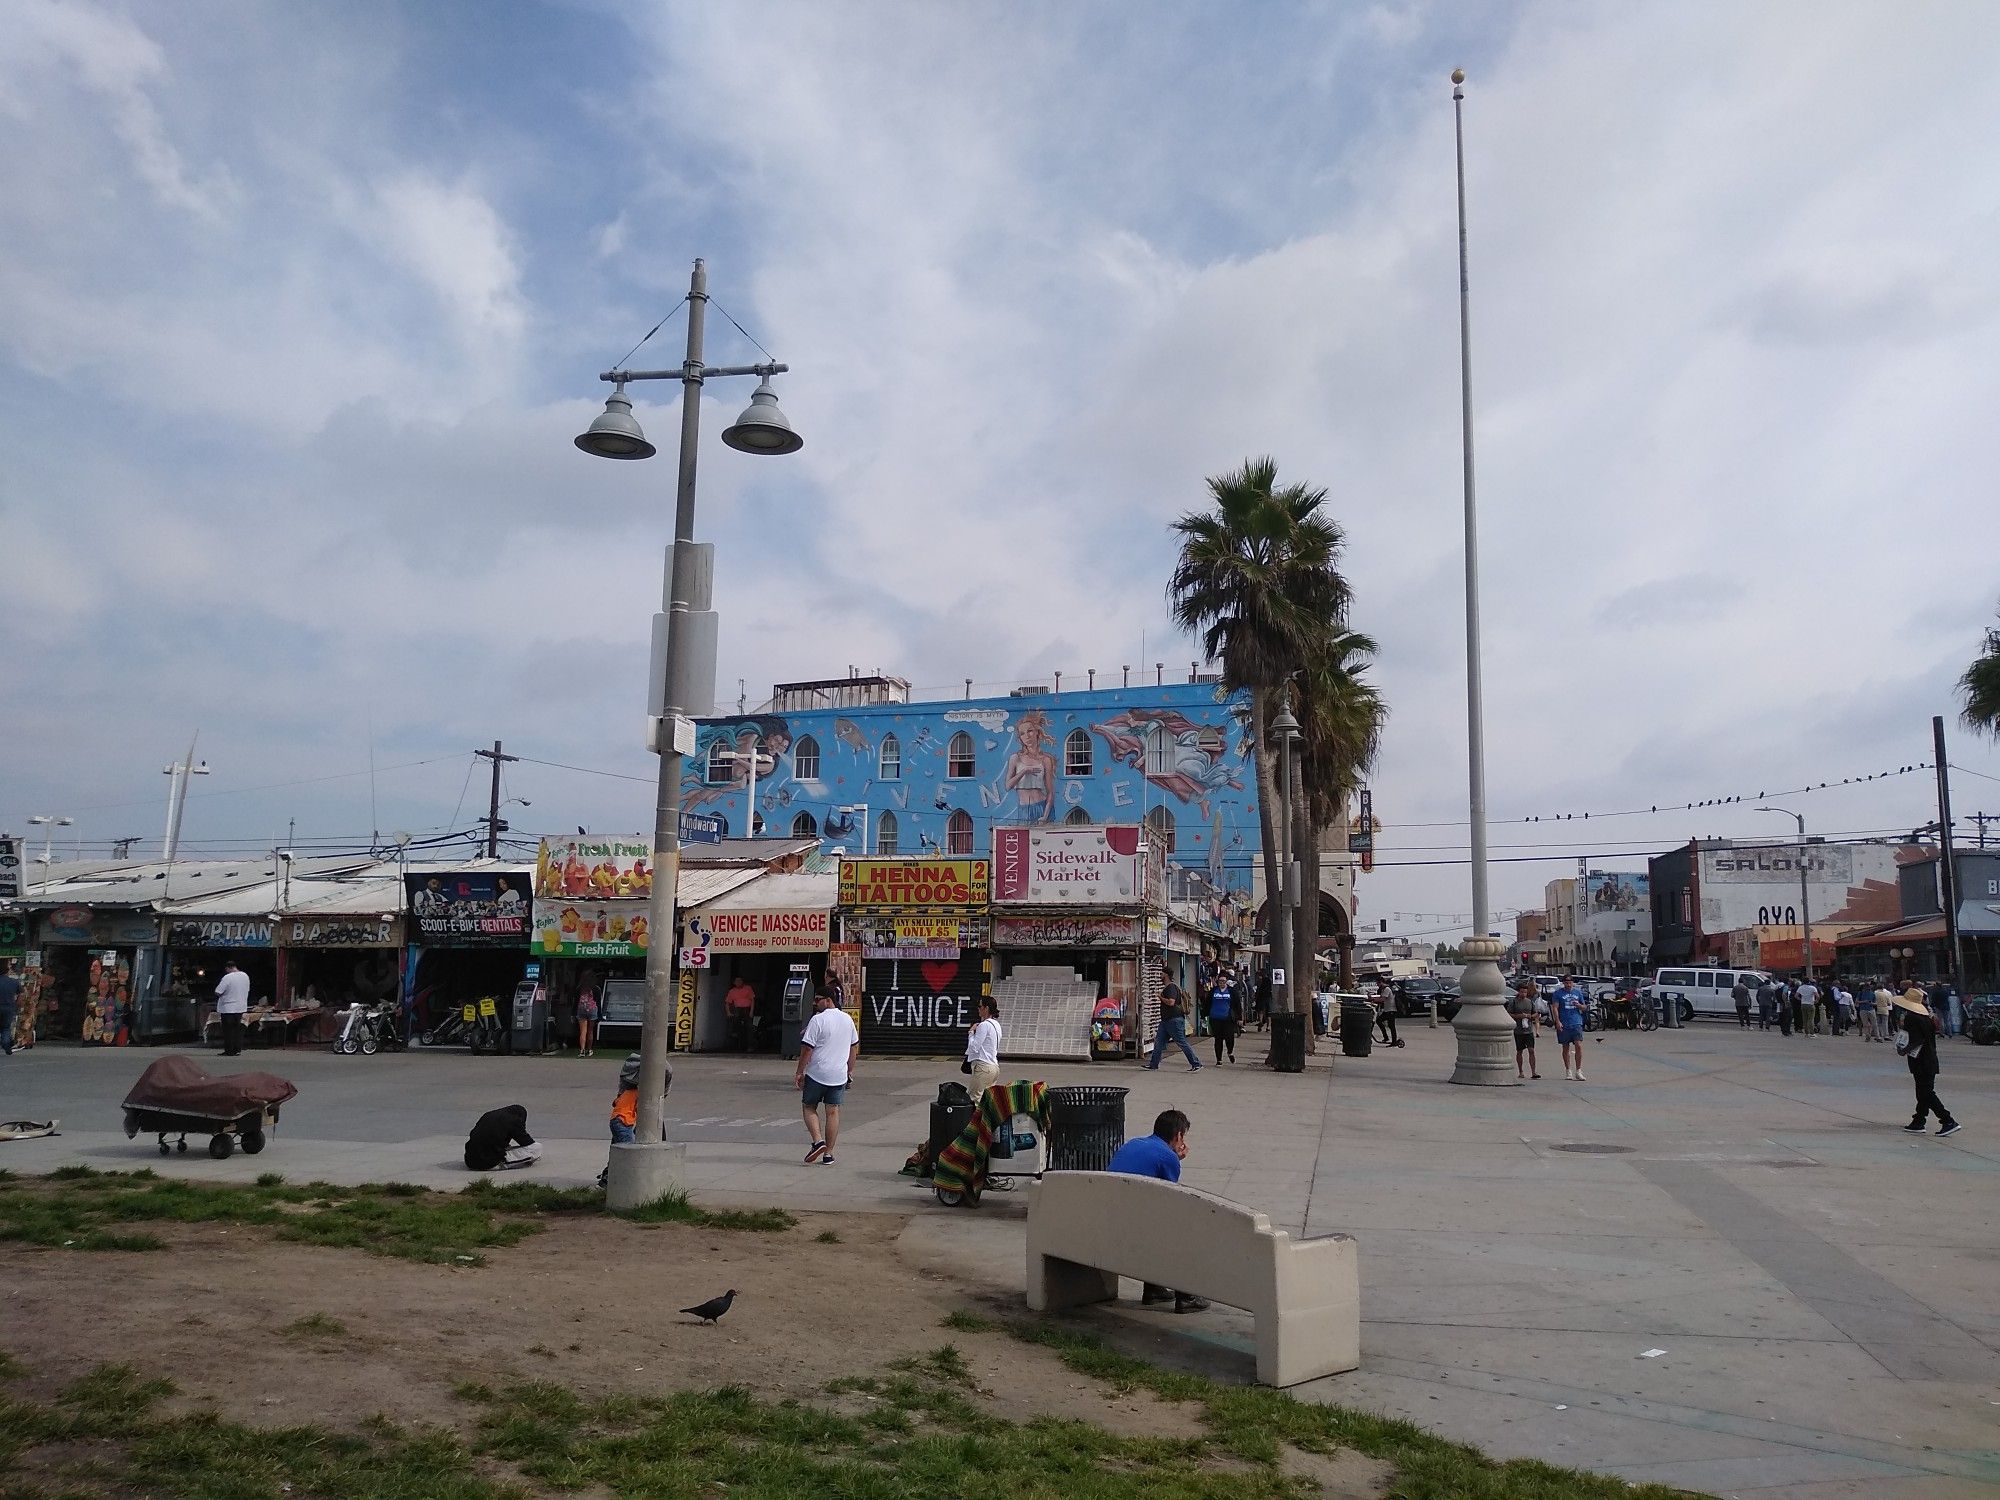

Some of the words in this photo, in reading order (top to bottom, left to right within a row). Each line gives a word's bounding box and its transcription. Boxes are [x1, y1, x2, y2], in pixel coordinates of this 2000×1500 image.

[1362, 793, 1370, 832] BAR
[681, 813, 716, 832] Windward
[614, 843, 649, 857] Fruit
[1036, 850, 1118, 864] Sidewalk
[842, 862, 854, 880] 2
[974, 862, 985, 880] 2
[1005, 832, 1019, 896] VENICE
[870, 867, 957, 883] HENNA
[1036, 868, 1102, 882] Market
[840, 882, 855, 890] FOR
[858, 884, 969, 903] TATTOOS
[971, 882, 986, 890] FOR
[1579, 858, 1587, 912] TATTOO
[840, 891, 855, 903] $10
[970, 891, 987, 902] $10
[710, 914, 758, 932] VENICE
[762, 913, 826, 932] MASSAGE
[896, 918, 911, 927] ANY
[911, 918, 934, 927] SMALL
[936, 918, 958, 927] PRINT
[1758, 906, 1796, 925] AYA
[292, 922, 392, 942] BAZAR
[420, 918, 481, 932] SCOOT-E-BIKE
[481, 918, 522, 932] RENTALS
[903, 927, 931, 937] ONLY
[936, 927, 950, 938] $5
[575, 943, 603, 955] Fresh
[605, 943, 630, 955] Fruit
[714, 937, 734, 947] BODY
[736, 937, 767, 948] Massage
[771, 936, 791, 946] FOOT
[793, 936, 824, 947] Massage
[682, 947, 707, 966] $5
[890, 959, 900, 991] I
[678, 968, 694, 1044] ASSAGE
[870, 995, 971, 1028] VENICE
